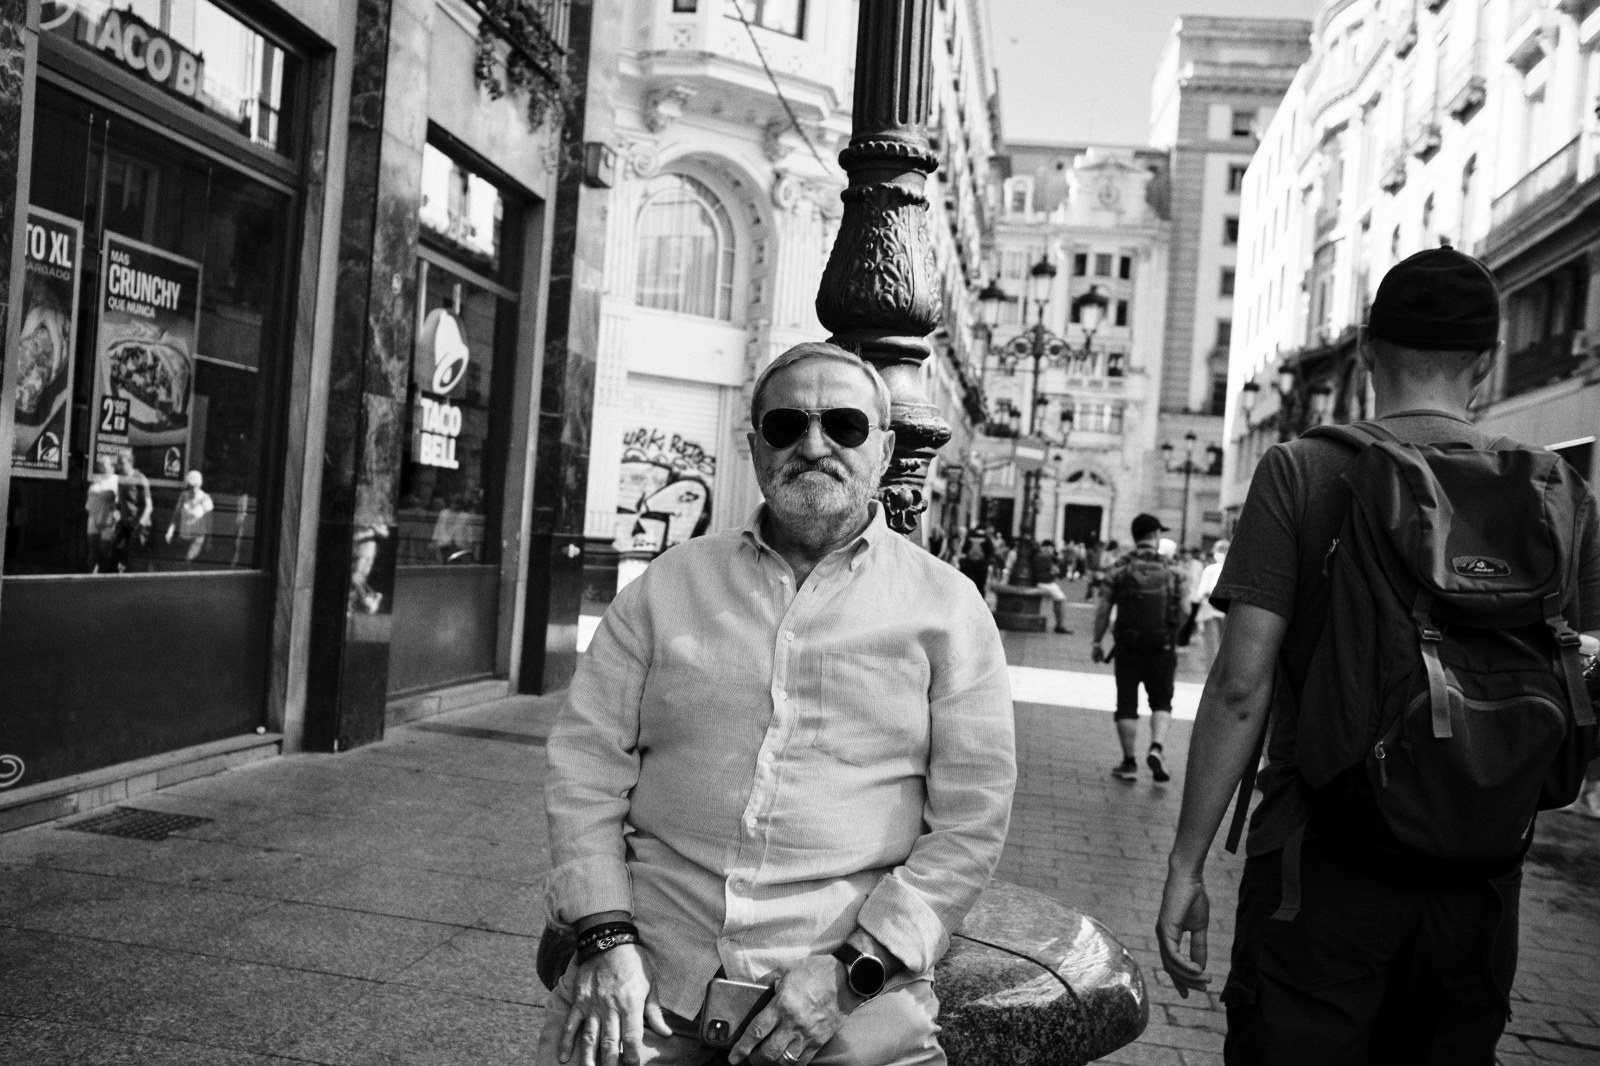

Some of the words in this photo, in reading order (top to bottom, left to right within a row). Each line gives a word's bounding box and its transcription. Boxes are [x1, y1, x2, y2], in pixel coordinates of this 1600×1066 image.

[49, 230, 72, 269] XL
[109, 263, 180, 311] CRUNCHY
[108, 296, 126, 312] QUE
[126, 300, 156, 319] NUNCA
[420, 397, 462, 437] TACO
[420, 431, 459, 470] BELL
